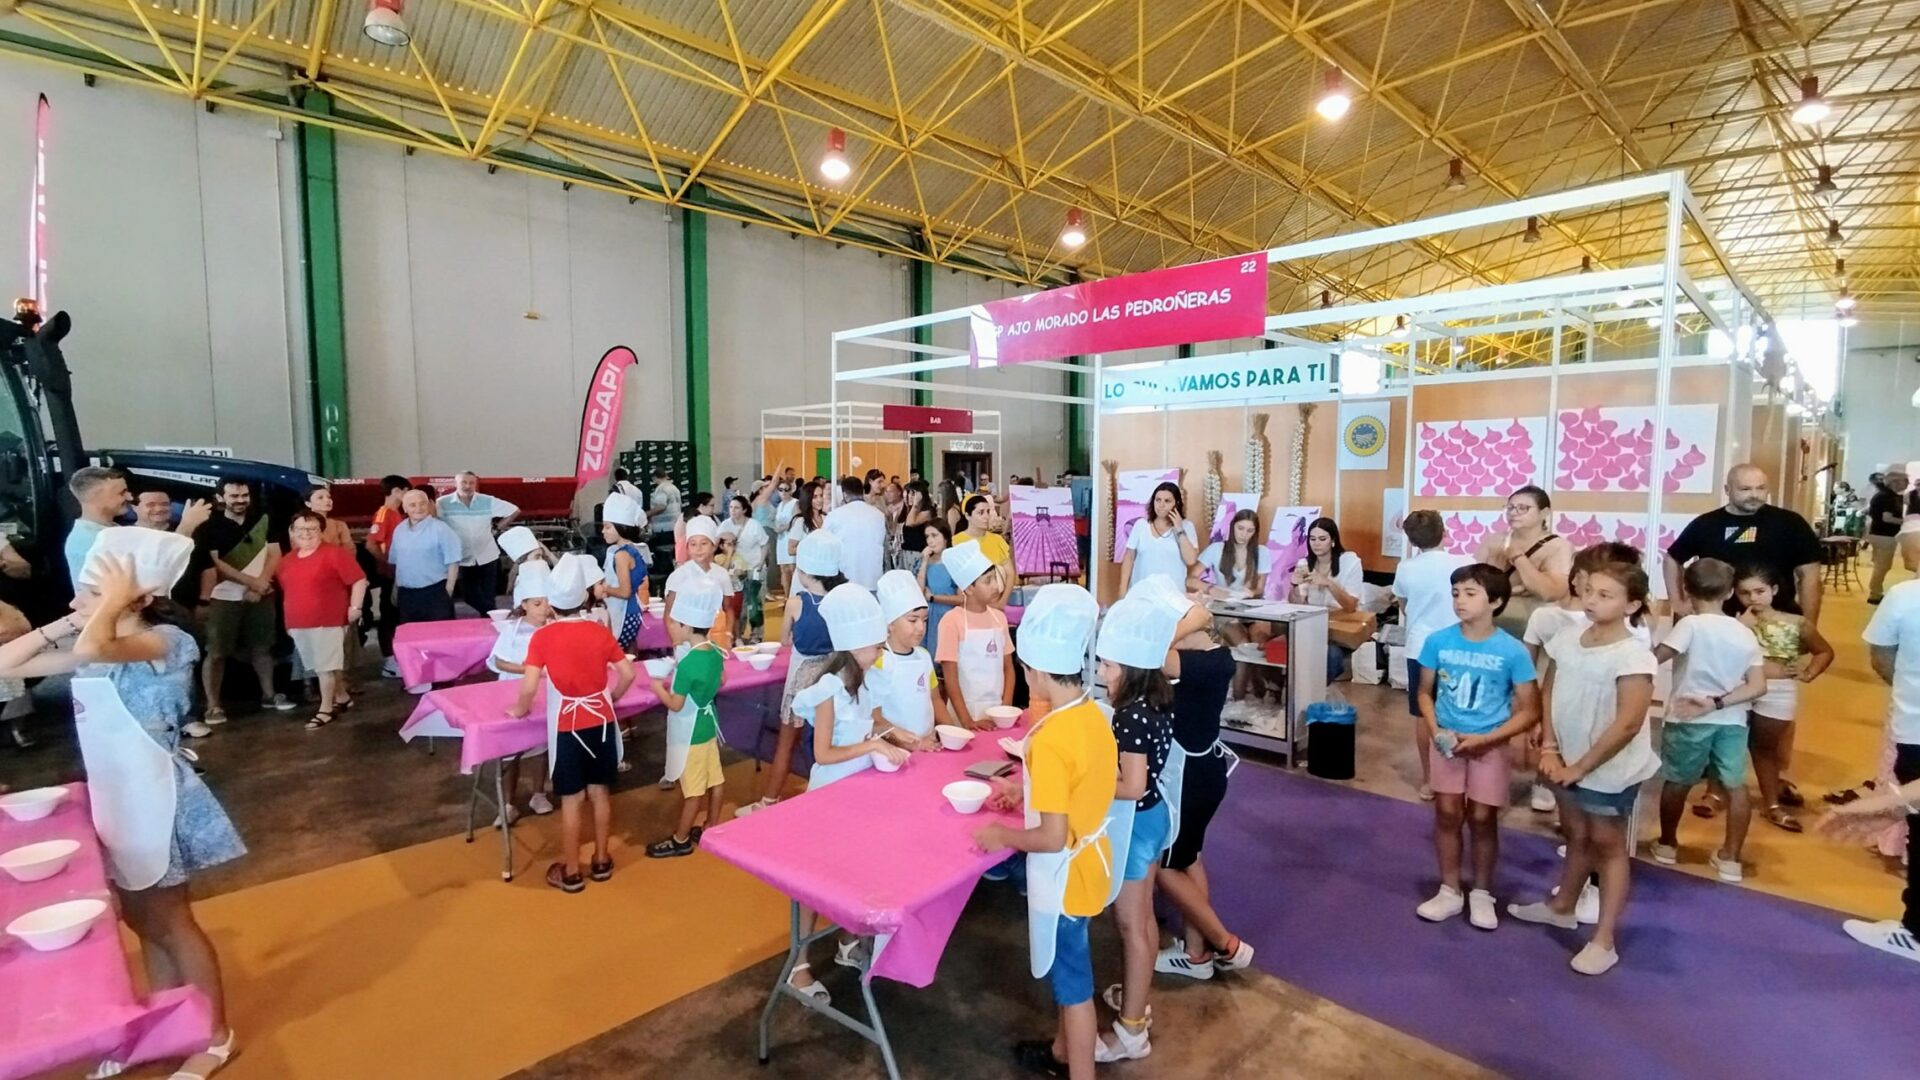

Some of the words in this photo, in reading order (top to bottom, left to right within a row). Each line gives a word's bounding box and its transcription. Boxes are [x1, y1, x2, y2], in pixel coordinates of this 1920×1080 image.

[1240, 260, 1257, 273] 22
[1008, 320, 1031, 337] AJO
[1035, 310, 1089, 333] MORADO
[1092, 305, 1120, 323] LAS
[1125, 288, 1232, 318] PEDROÑERAS
[1104, 382, 1125, 399] LO
[1246, 365, 1301, 387] PARA
[1307, 362, 1326, 382] TI
[582, 361, 621, 472] ZOCAPI
